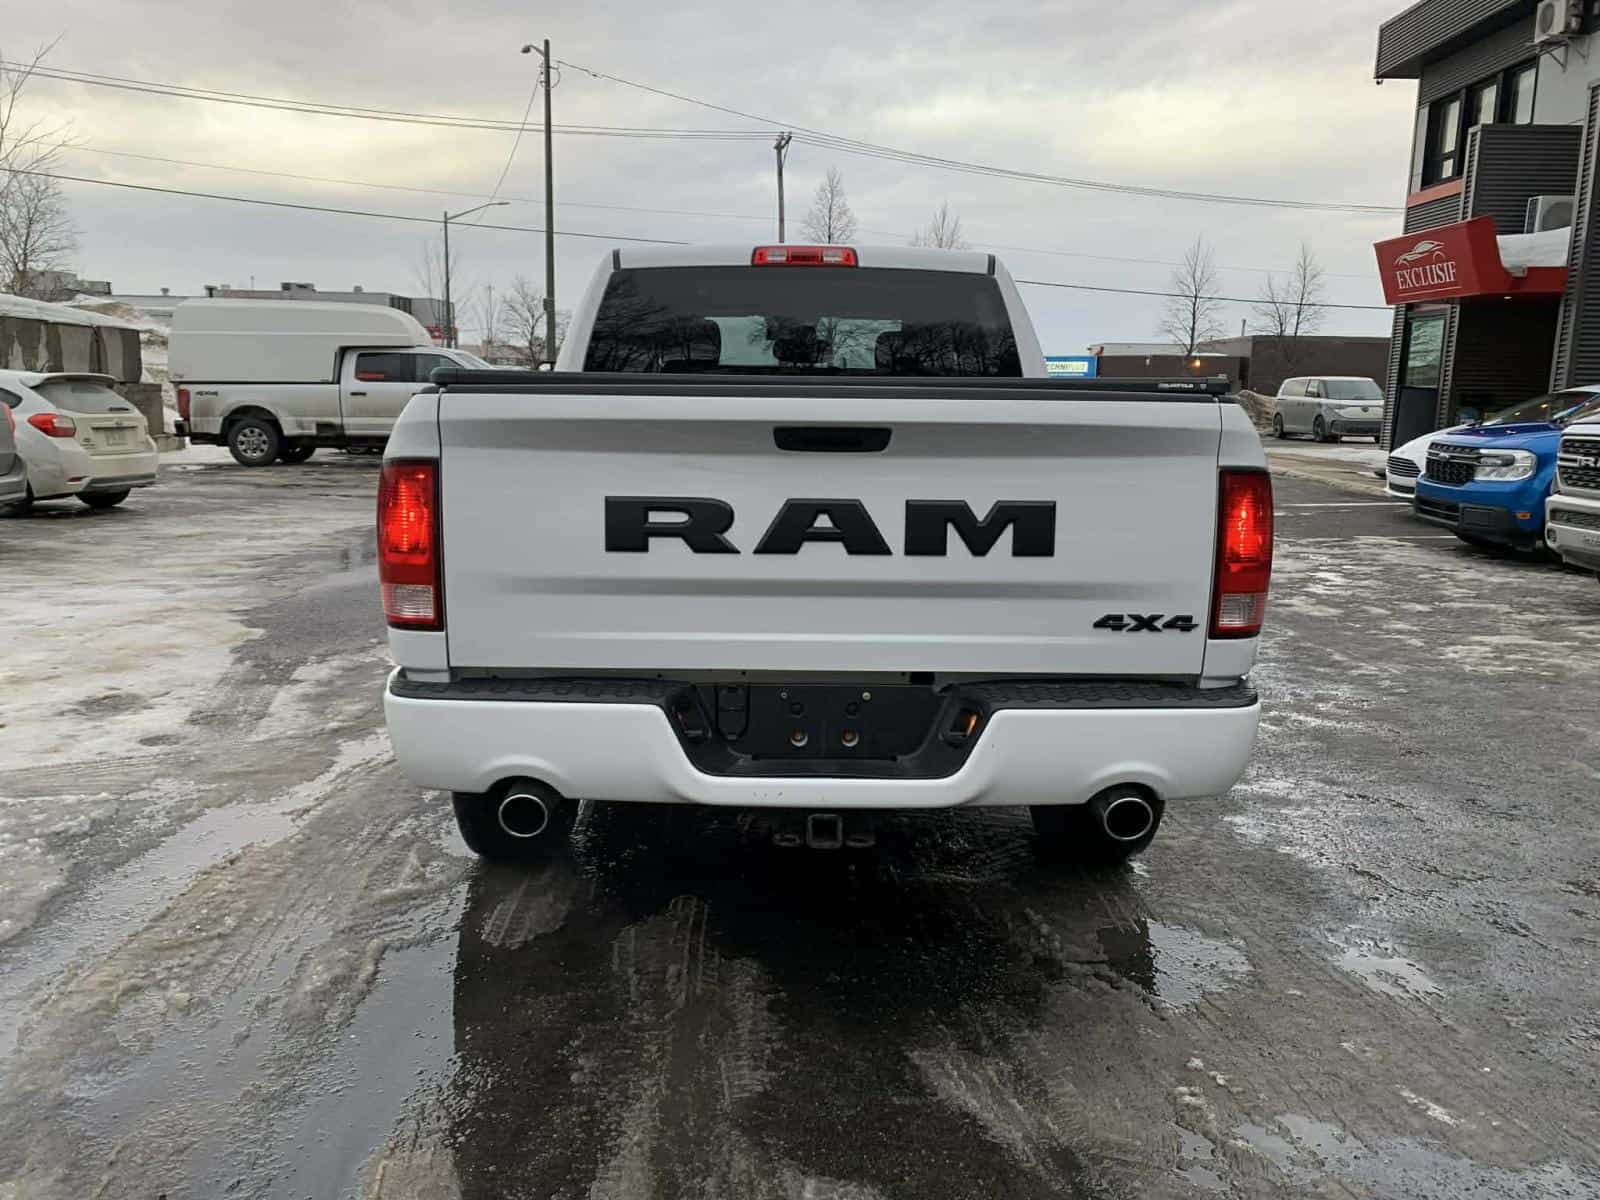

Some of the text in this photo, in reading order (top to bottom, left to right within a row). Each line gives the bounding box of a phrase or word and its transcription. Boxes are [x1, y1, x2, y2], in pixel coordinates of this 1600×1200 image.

[1396, 261, 1457, 289] EXCLUSIF
[605, 496, 1057, 557] RAM
[1093, 614, 1199, 632] 4X4
